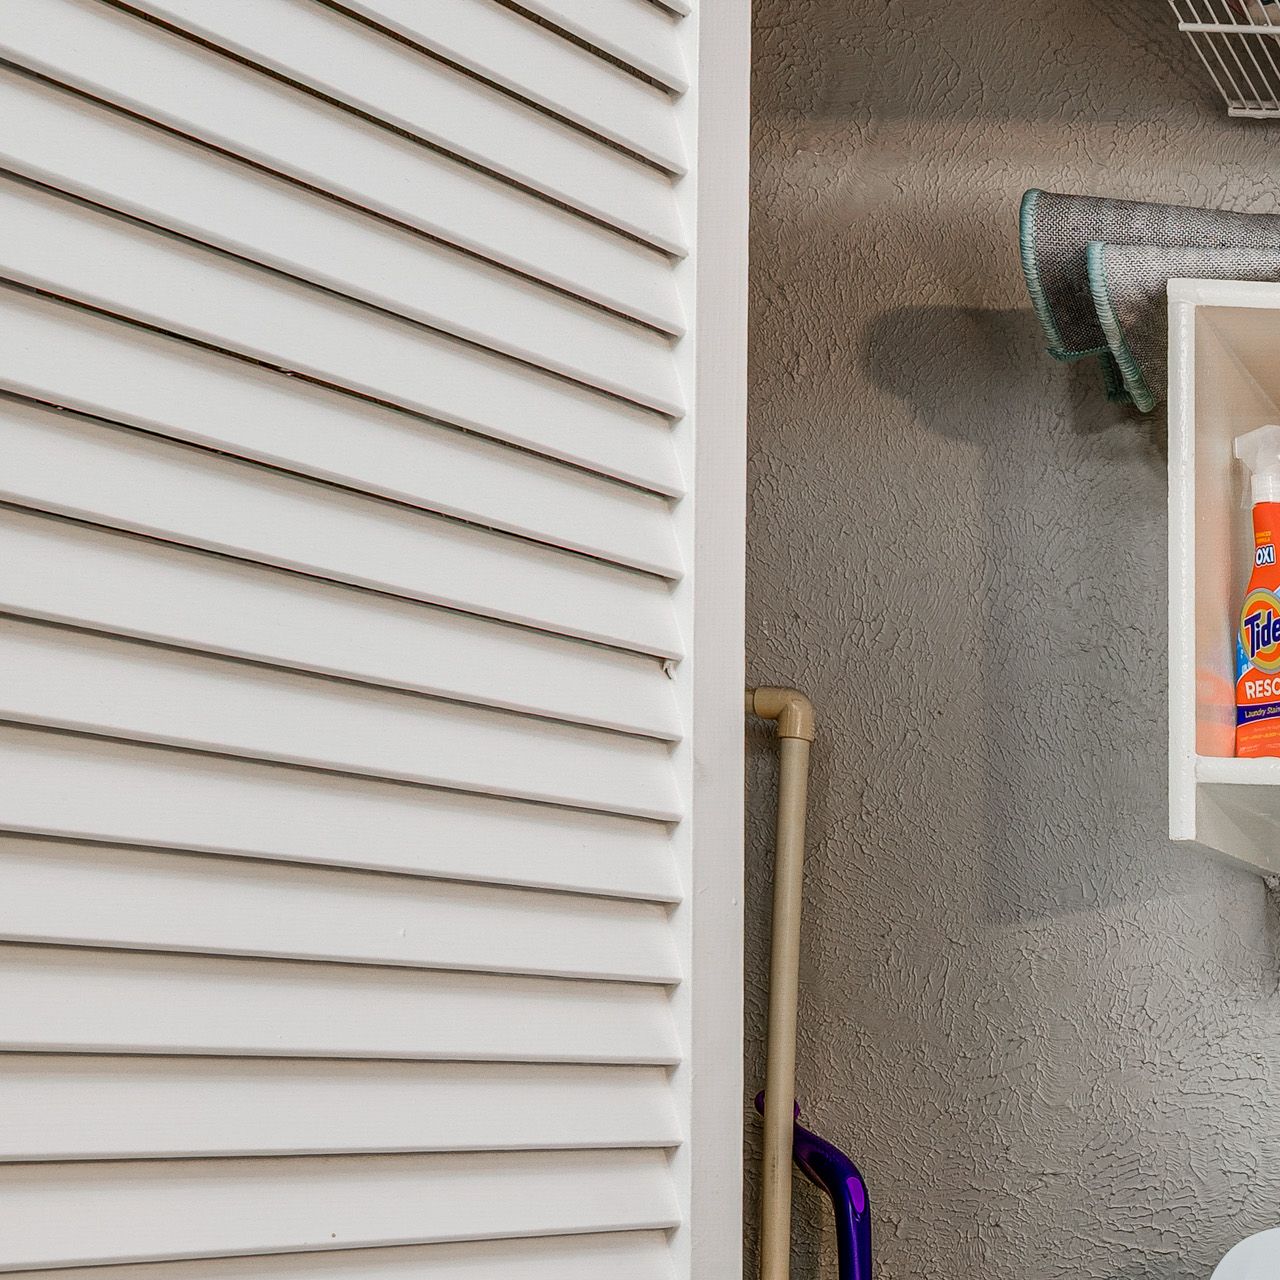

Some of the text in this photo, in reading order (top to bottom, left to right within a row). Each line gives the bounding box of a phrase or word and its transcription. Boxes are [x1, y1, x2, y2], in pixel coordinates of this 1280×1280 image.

[1255, 546, 1275, 566] OXI
[1244, 708, 1266, 718] Laundry
[1266, 706, 1280, 714] Stain
